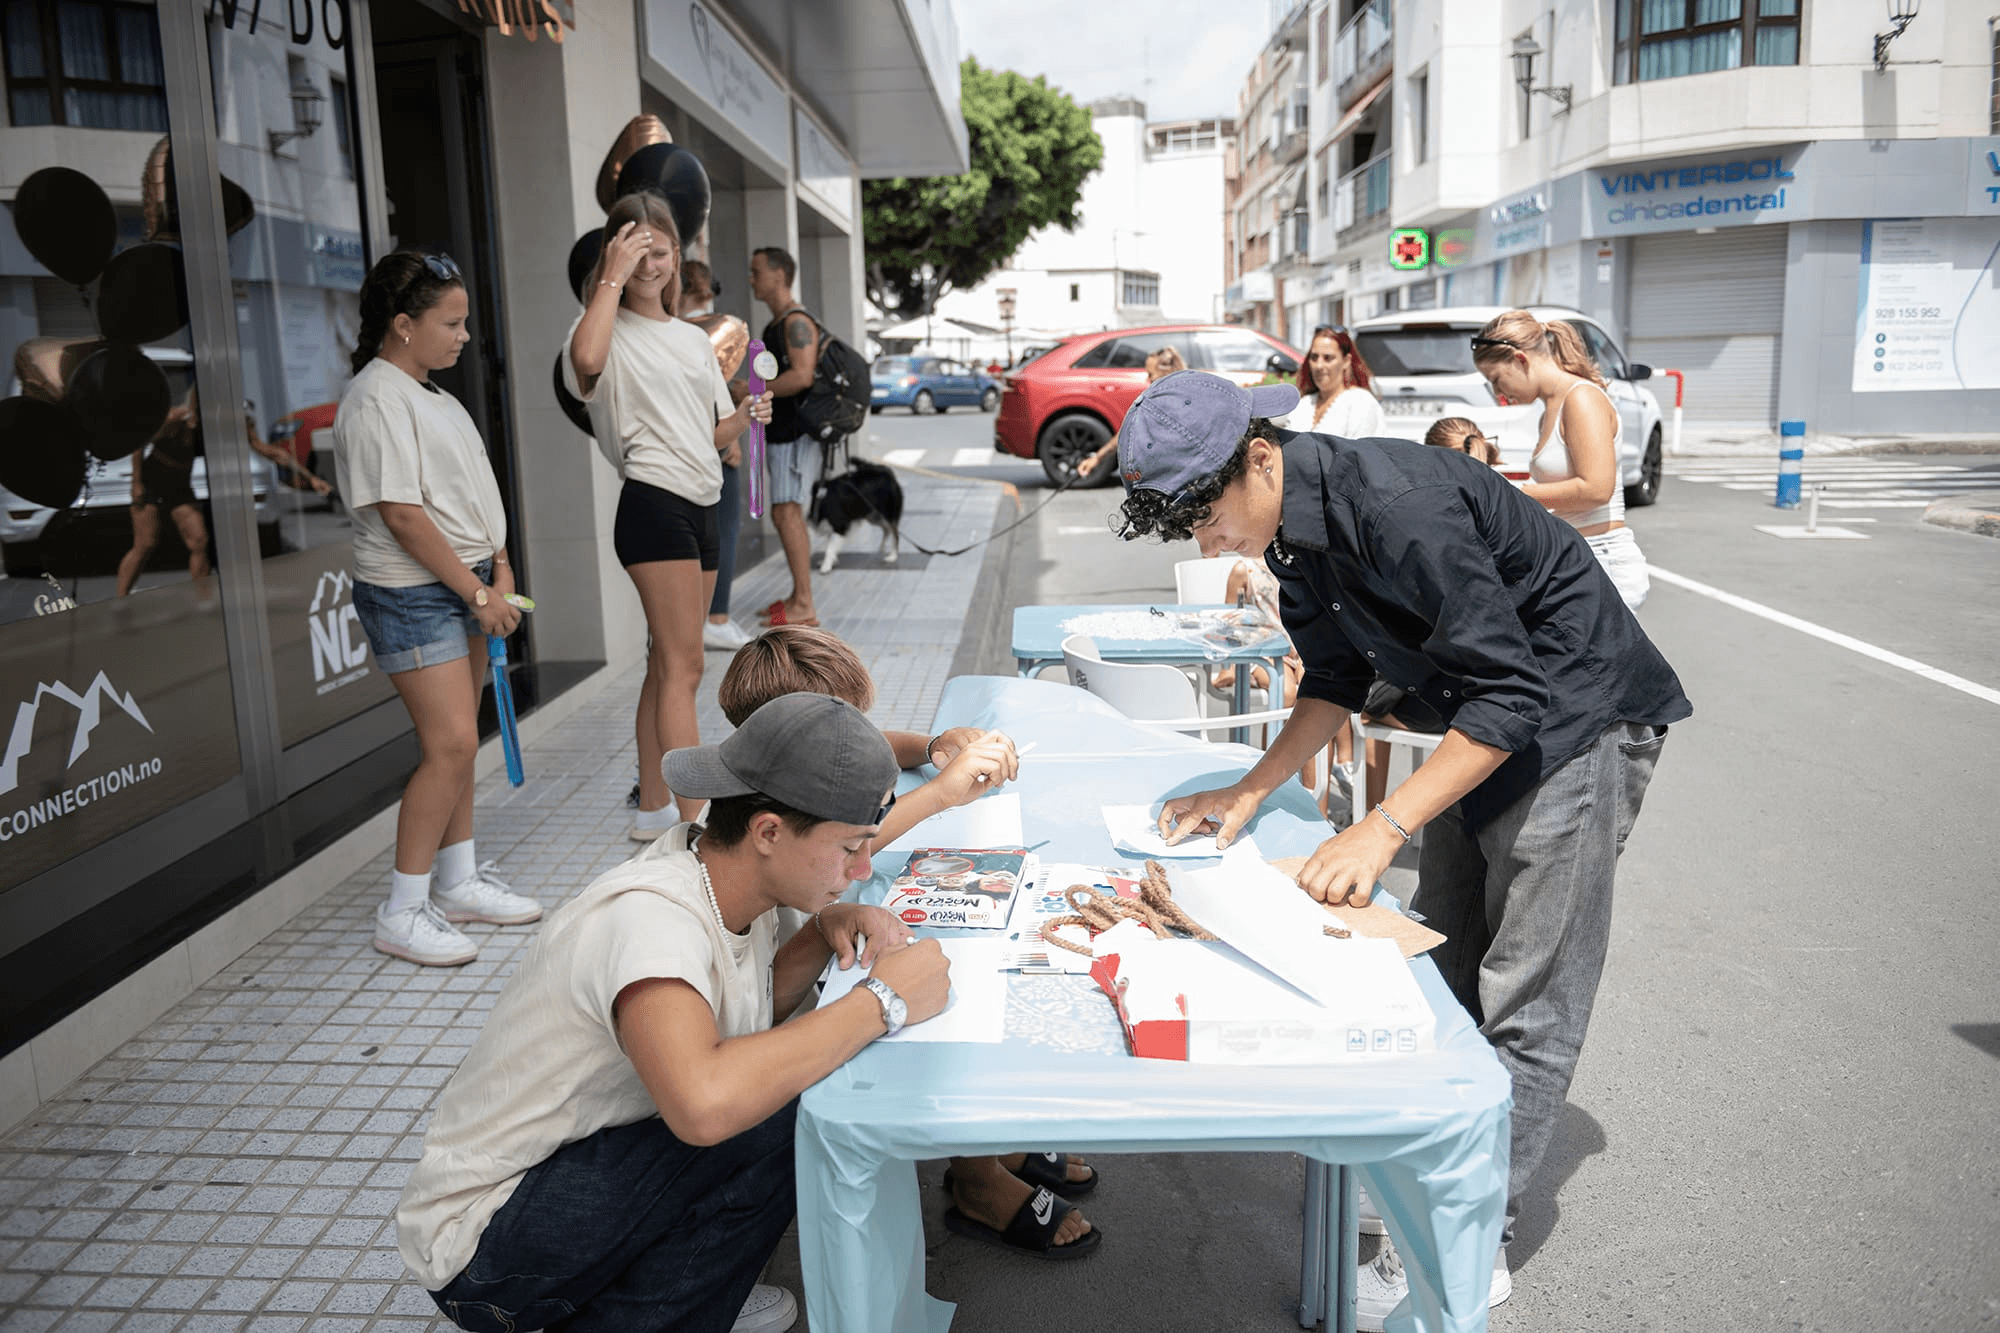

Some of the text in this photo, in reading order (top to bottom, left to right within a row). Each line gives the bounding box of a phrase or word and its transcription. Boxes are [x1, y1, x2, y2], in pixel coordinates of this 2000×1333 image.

[1601, 158, 1795, 197] VINTERSOL
[1875, 307, 1941, 319] 928 155 952
[309, 603, 368, 682] NC
[0, 757, 163, 841] CONNECTION.no
[1031, 1188, 1050, 1216] NIKE
